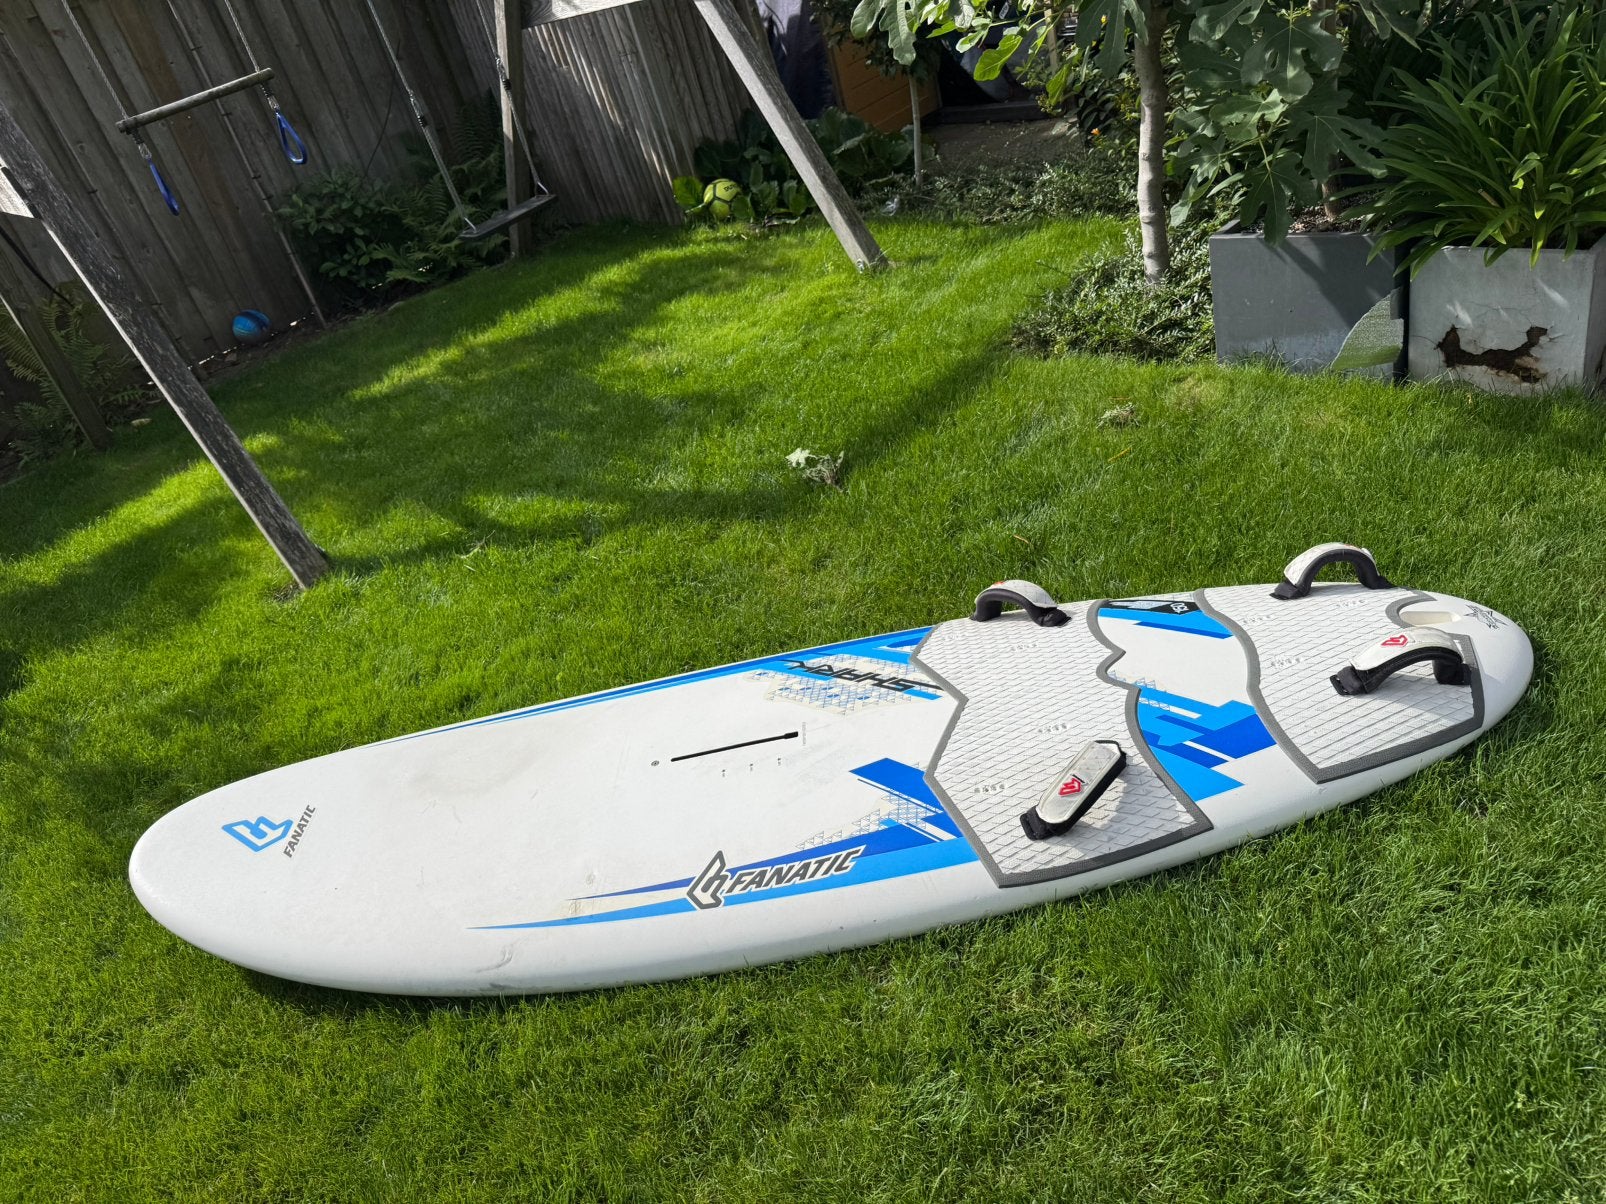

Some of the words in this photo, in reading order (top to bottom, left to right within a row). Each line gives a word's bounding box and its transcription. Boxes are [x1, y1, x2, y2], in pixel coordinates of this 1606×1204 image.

[779, 659, 945, 692] SHARK
[284, 804, 316, 858] FANATIC
[726, 848, 861, 894] FANATIC
